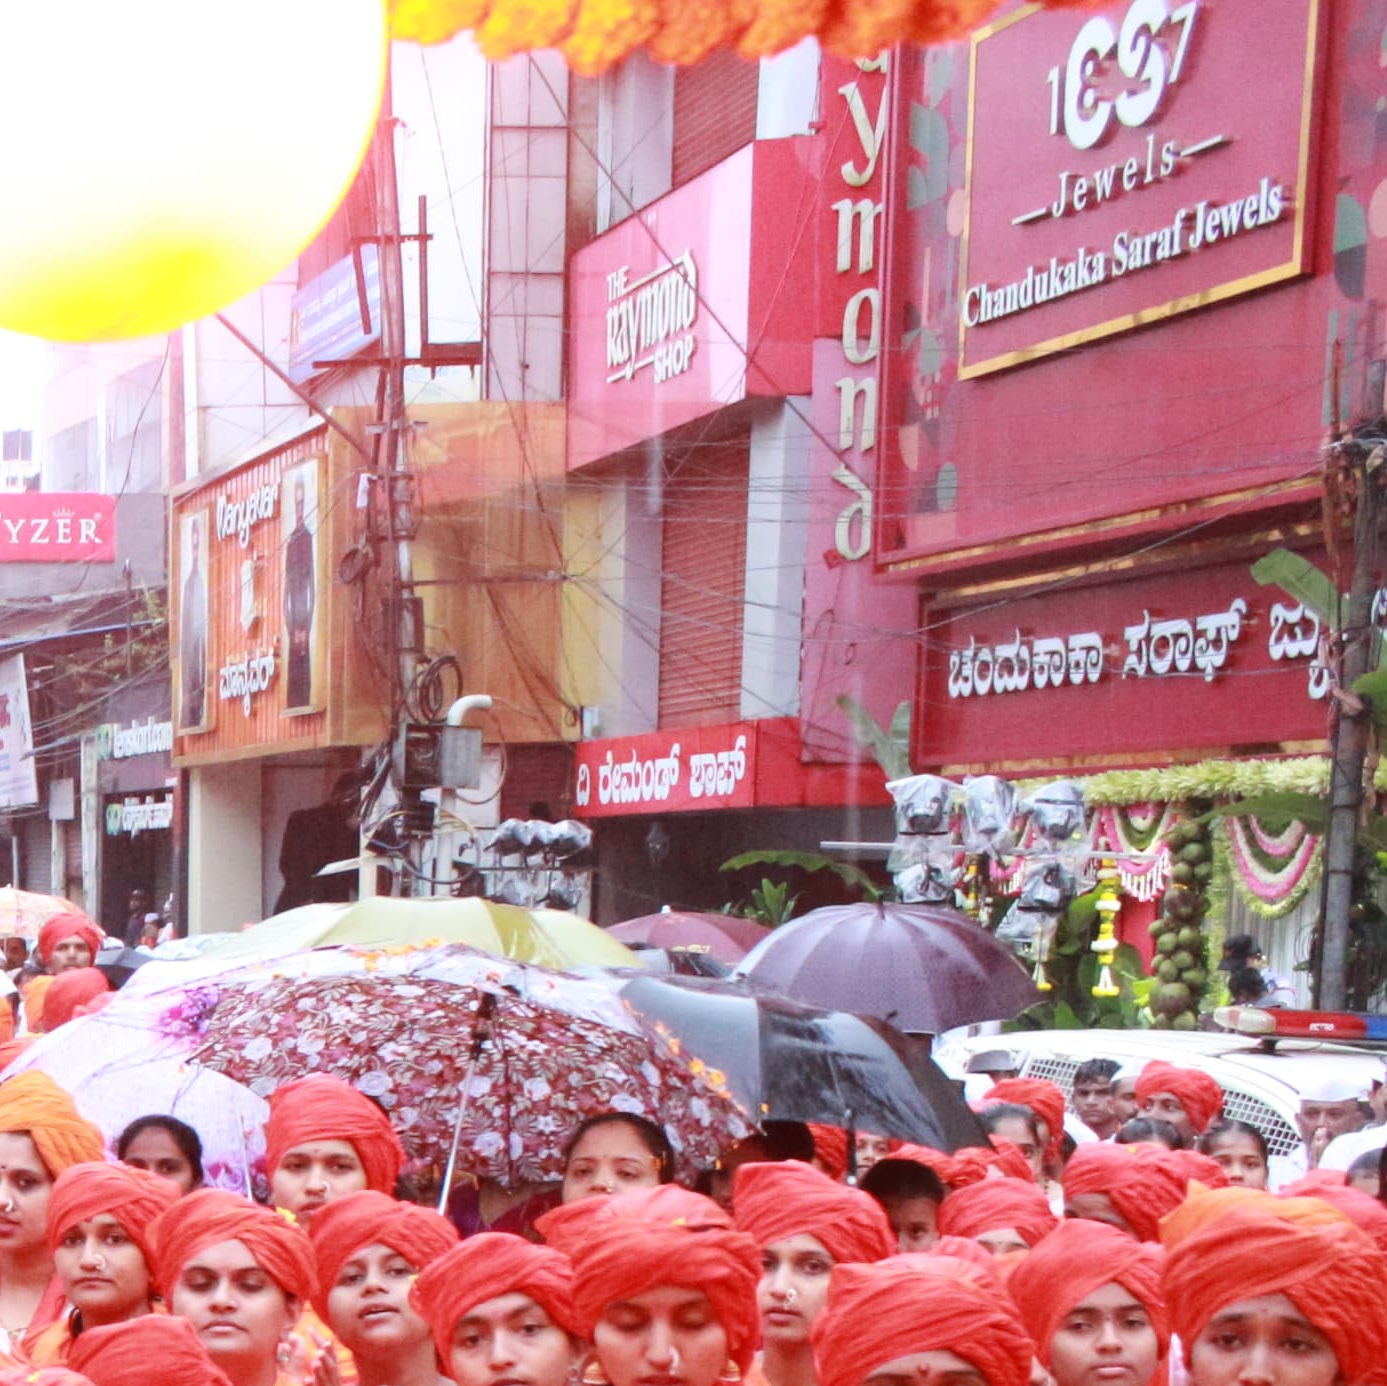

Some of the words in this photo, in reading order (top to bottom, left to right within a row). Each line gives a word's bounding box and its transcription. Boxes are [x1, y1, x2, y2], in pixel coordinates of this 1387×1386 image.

[1052, 133, 1177, 218] Jewels
[963, 247, 1105, 328] Chandukaka
[1111, 207, 1185, 276] Saraf
[1188, 177, 1284, 250] Jewels
[607, 264, 630, 303] THE
[653, 334, 696, 384] SHOP
[217, 483, 279, 549] Manyavar
[576, 763, 591, 806] ದಿ
